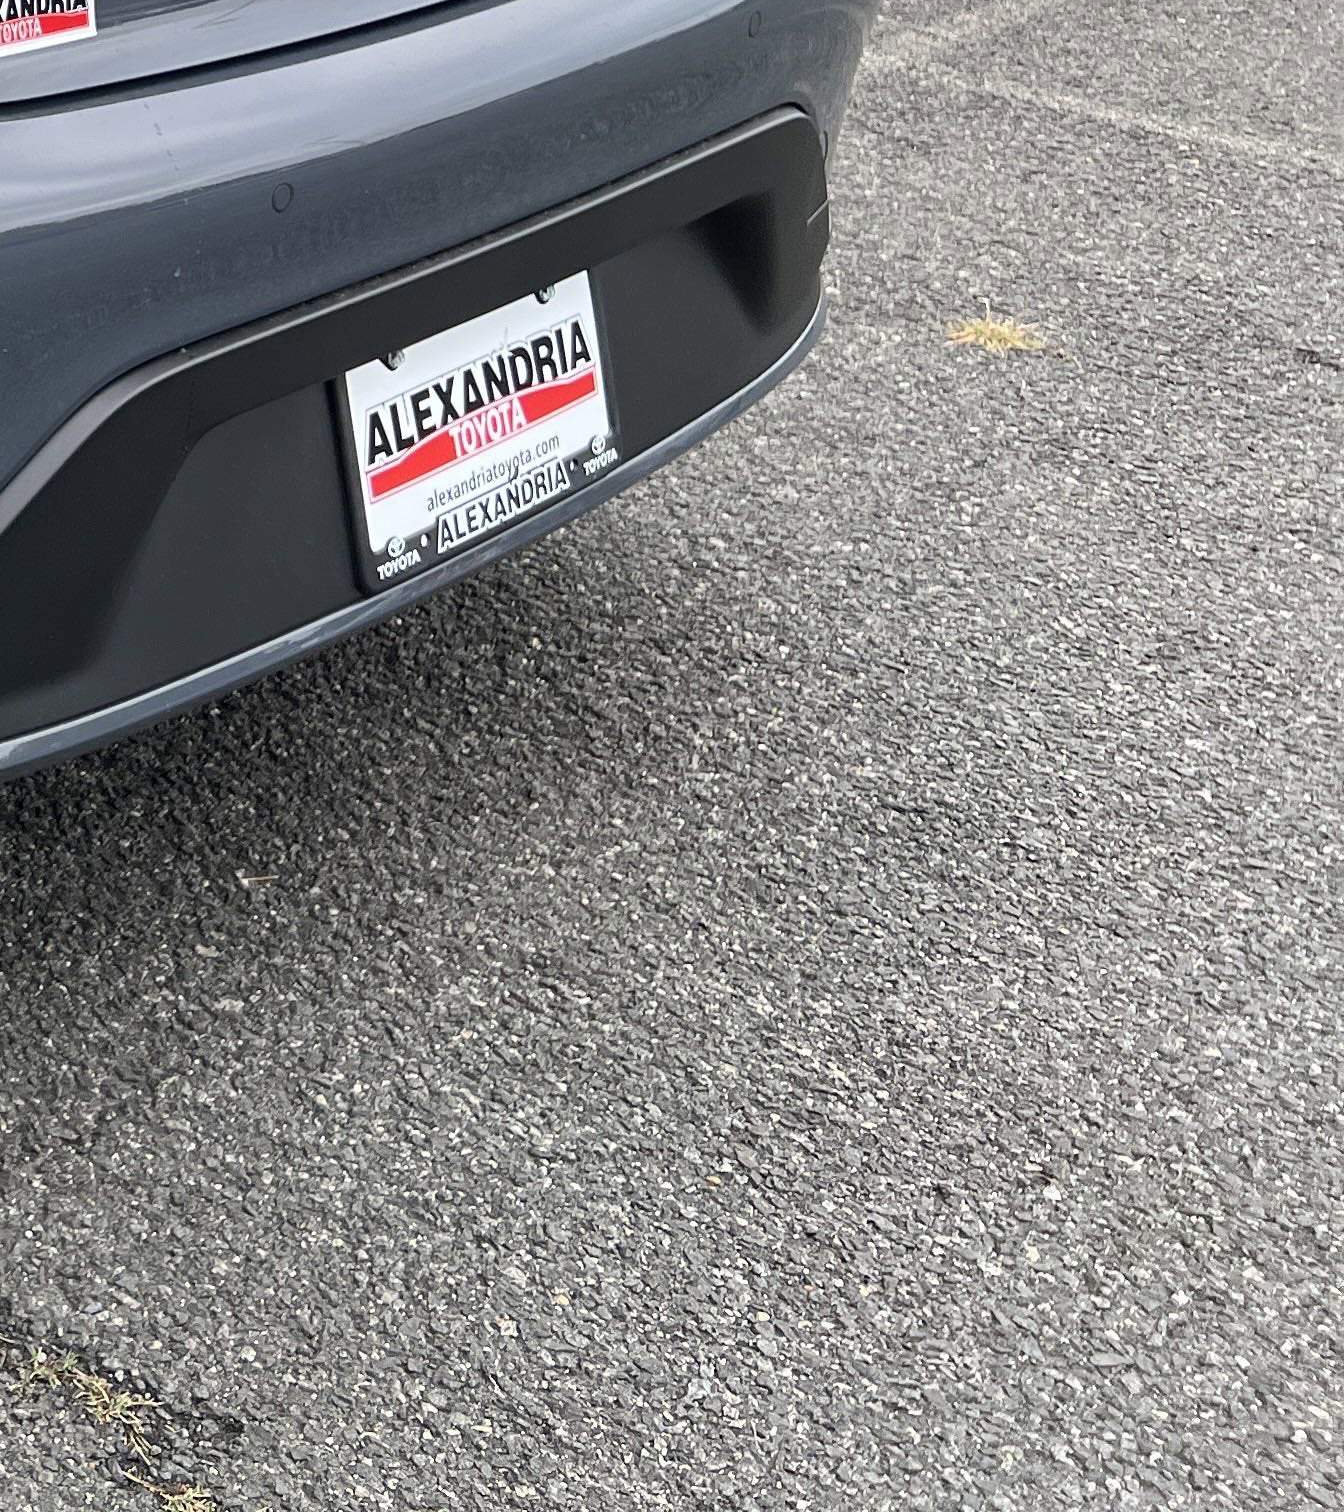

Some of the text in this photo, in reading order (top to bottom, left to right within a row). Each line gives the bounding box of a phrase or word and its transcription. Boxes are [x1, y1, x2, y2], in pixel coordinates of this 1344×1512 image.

[368, 321, 591, 466] ALEXANDRIA
[449, 398, 529, 458] TOYOTA
[377, 447, 619, 581] TOYOTA ALEXANDRIA TOYOTA
[426, 433, 561, 513] alexandriatoyota.com
